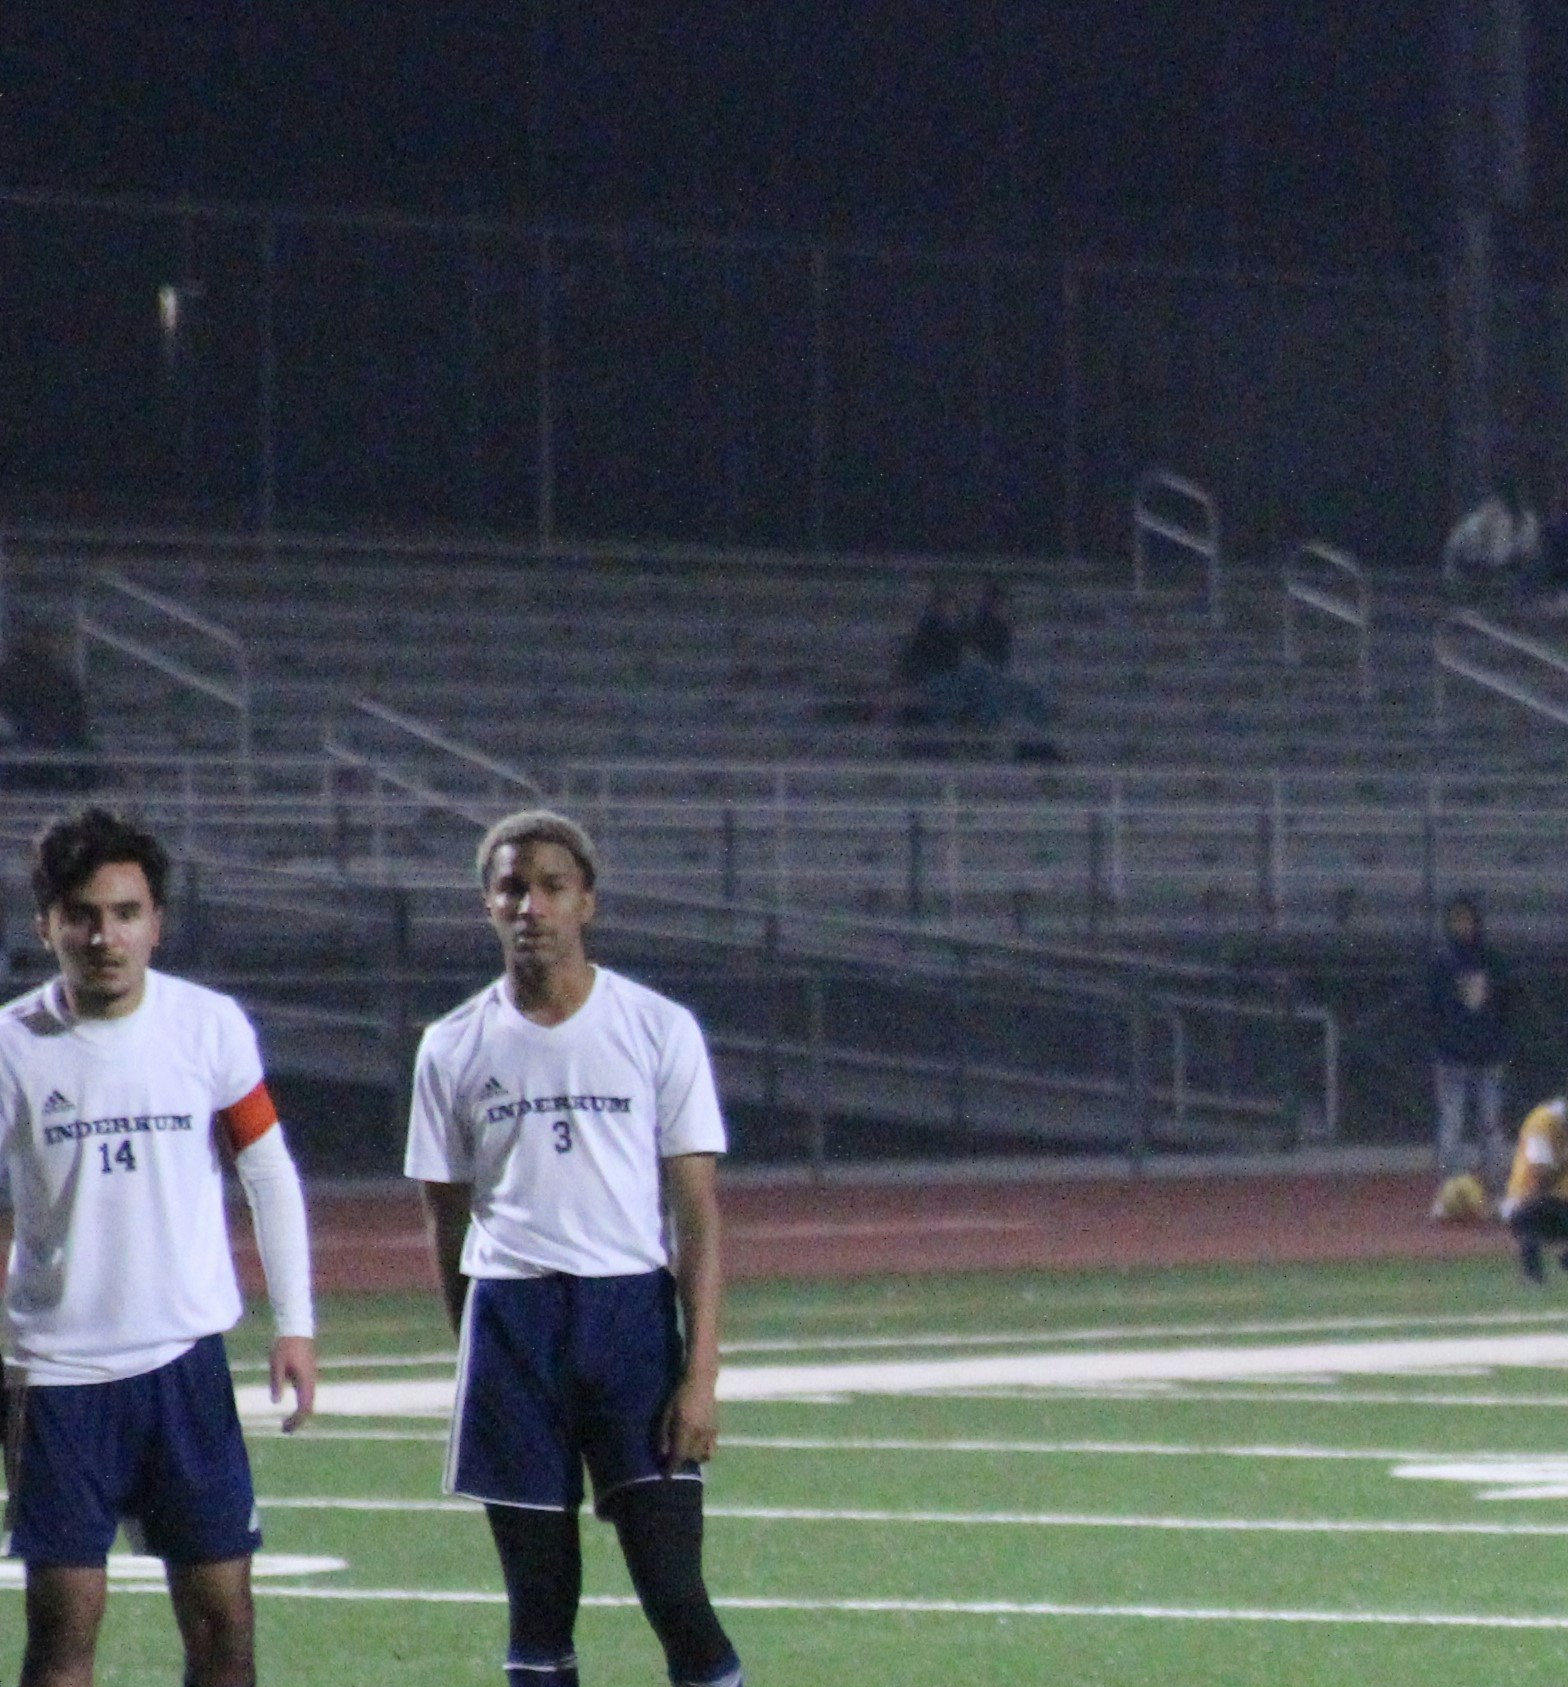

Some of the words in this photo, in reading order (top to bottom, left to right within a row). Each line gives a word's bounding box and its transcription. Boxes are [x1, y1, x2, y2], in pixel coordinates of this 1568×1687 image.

[43, 1115, 191, 1145] INDERKUM
[552, 1121, 573, 1154] 3
[99, 1140, 136, 1174] 14
